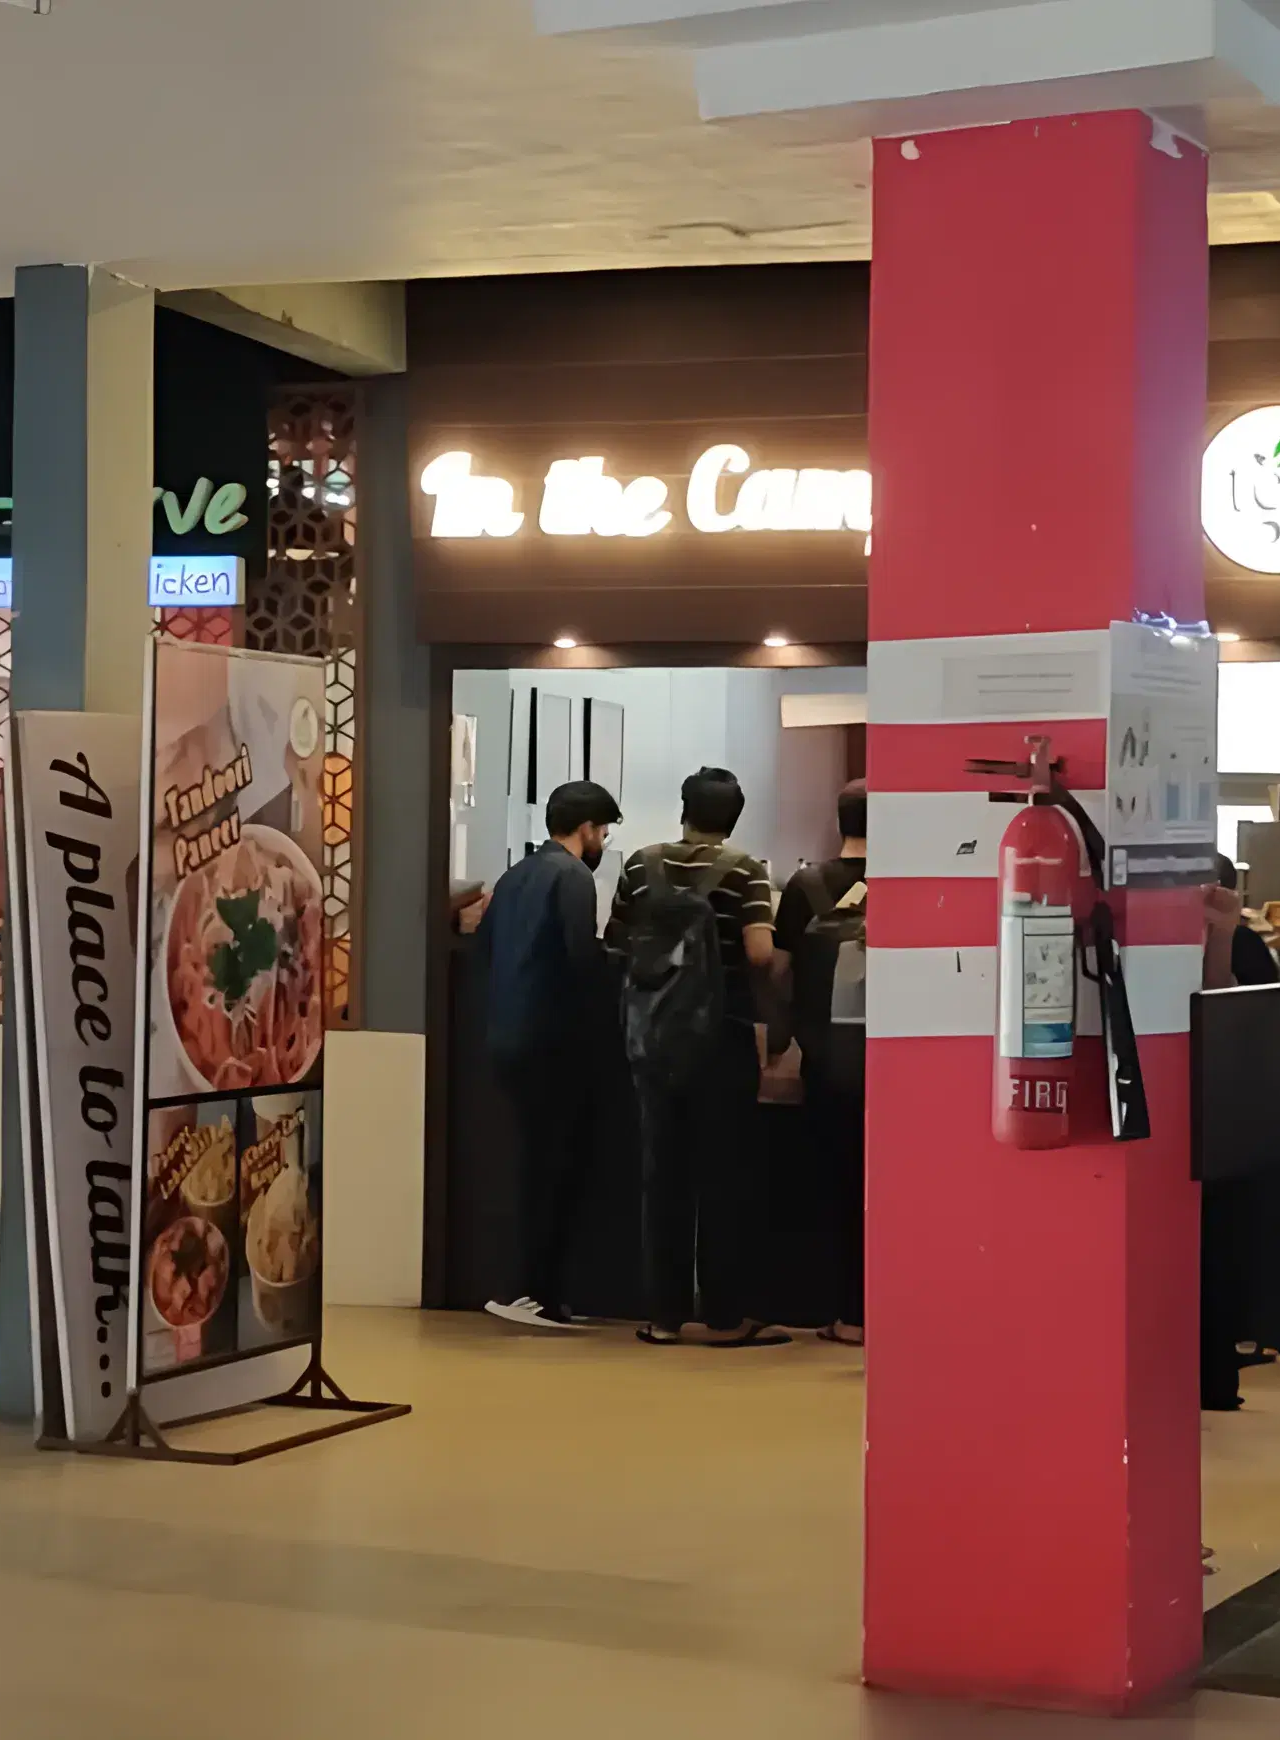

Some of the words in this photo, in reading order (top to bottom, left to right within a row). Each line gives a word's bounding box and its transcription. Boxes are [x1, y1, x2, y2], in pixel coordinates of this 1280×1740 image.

[420, 450, 525, 538] In
[538, 455, 672, 537] the
[153, 562, 231, 596] icken
[49, 751, 113, 819] A
[45, 830, 115, 1047] place
[81, 1065, 125, 1150] to
